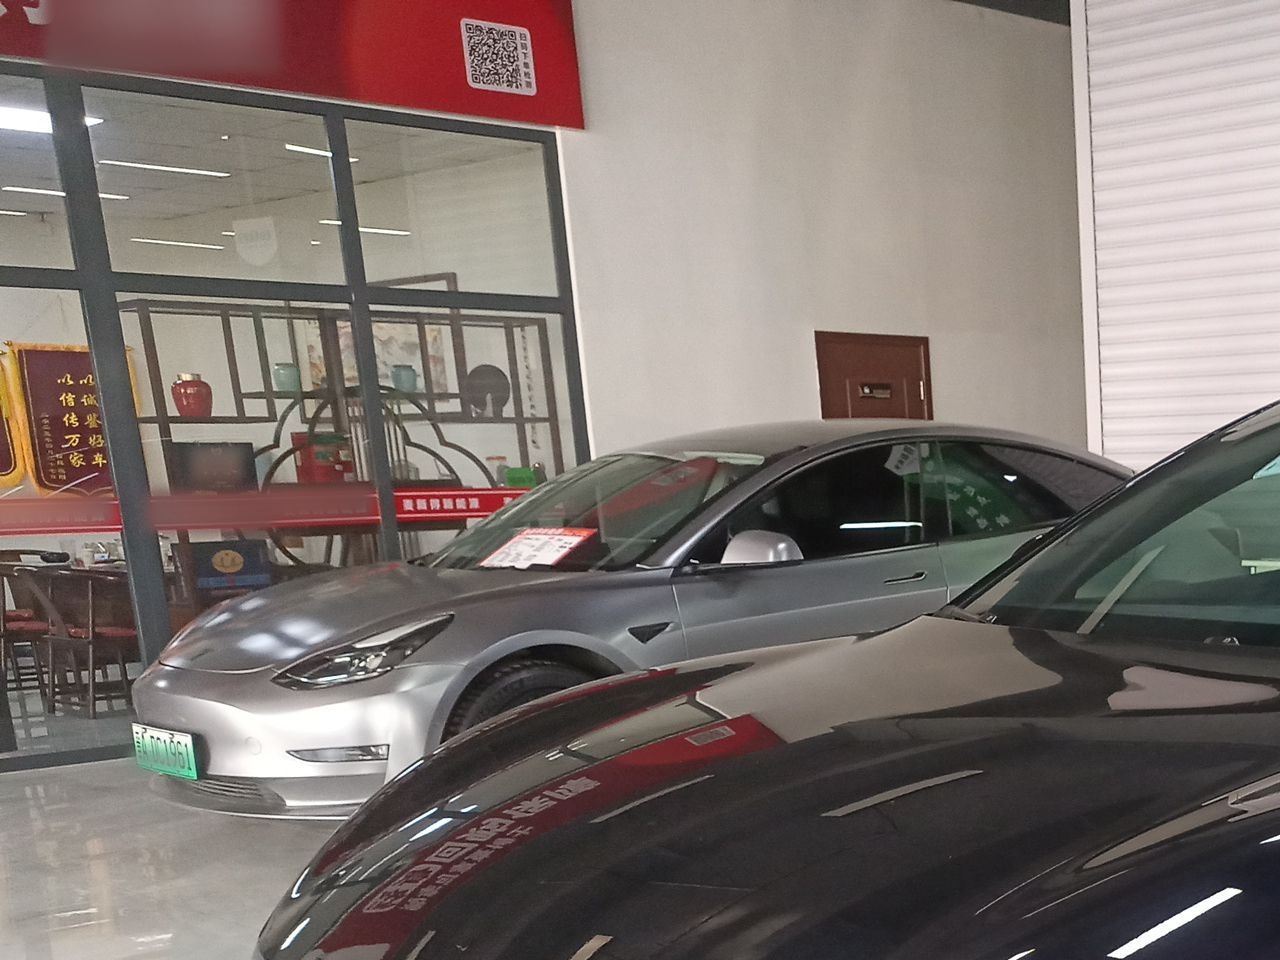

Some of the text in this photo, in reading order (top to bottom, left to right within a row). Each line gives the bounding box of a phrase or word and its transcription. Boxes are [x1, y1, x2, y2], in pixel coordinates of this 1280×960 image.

[57, 373, 86, 467] 以信传万家
